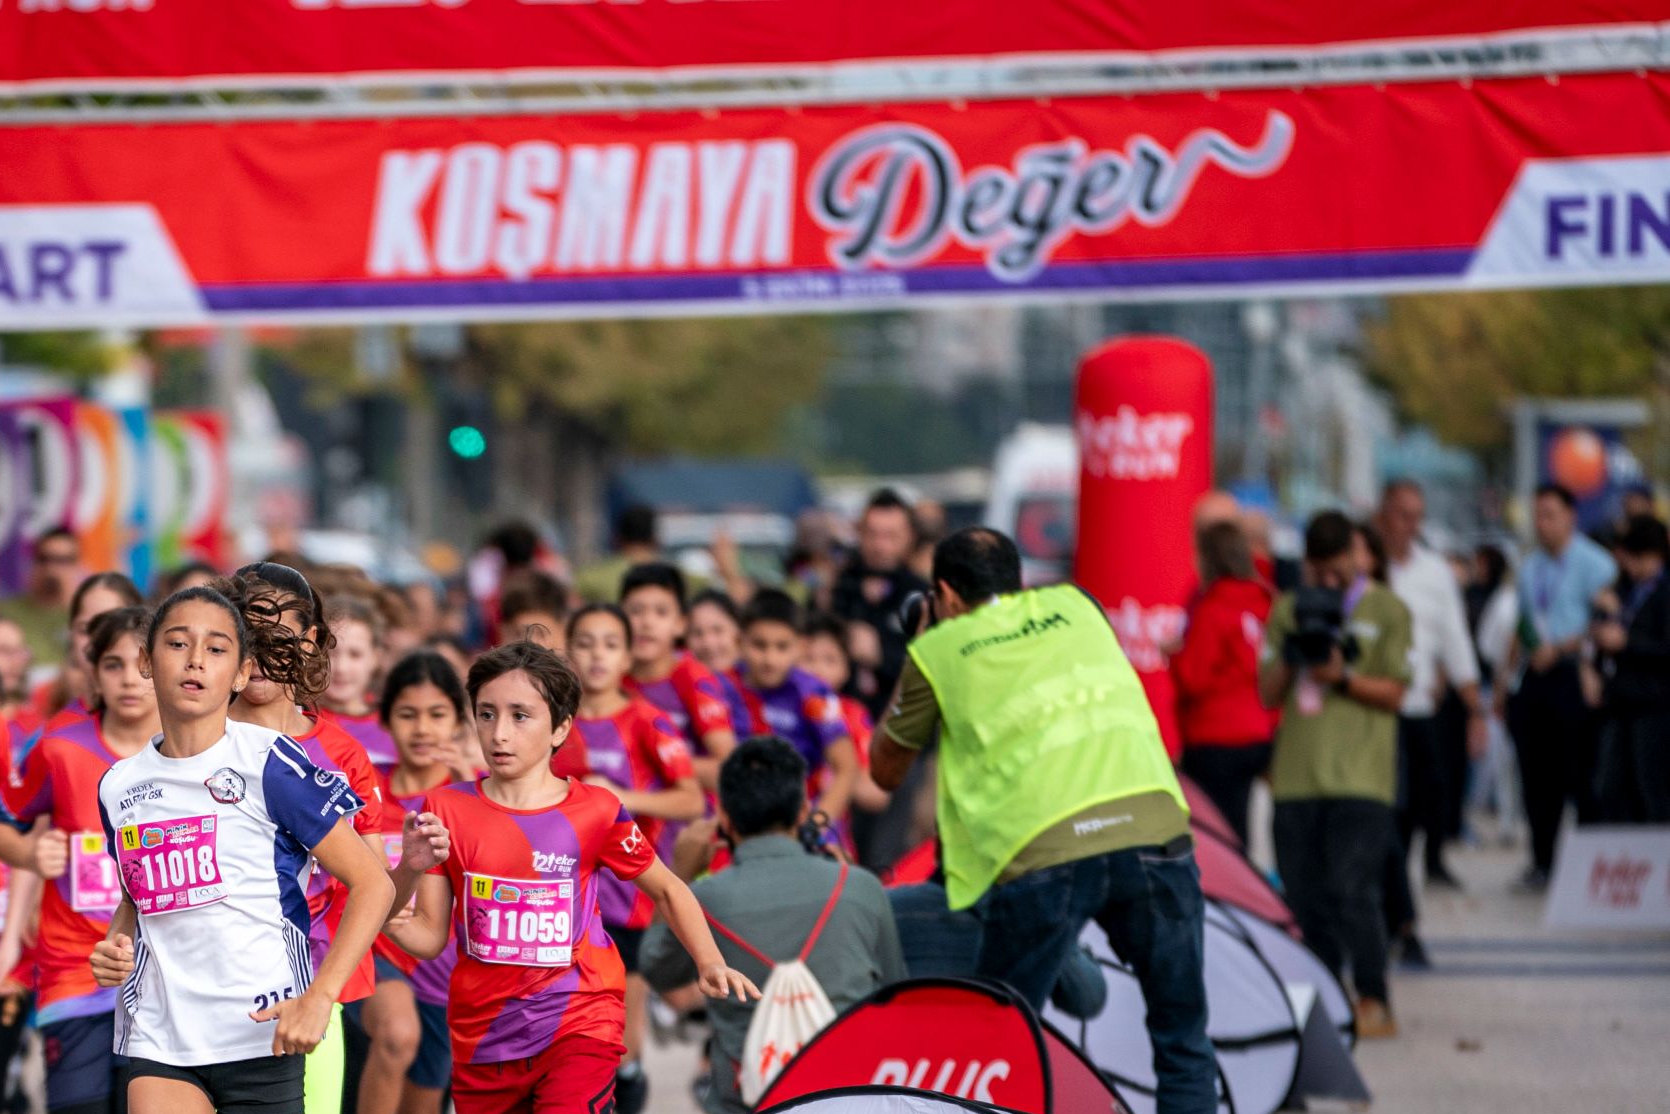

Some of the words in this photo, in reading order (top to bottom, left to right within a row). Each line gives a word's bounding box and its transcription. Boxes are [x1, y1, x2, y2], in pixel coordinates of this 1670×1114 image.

[368, 140, 794, 282] KOŞMAYA
[808, 118, 1297, 284] Değer
[124, 829, 134, 844] 11
[141, 845, 217, 892] 11018
[475, 879, 486, 894] 11
[487, 908, 571, 944] 11059
